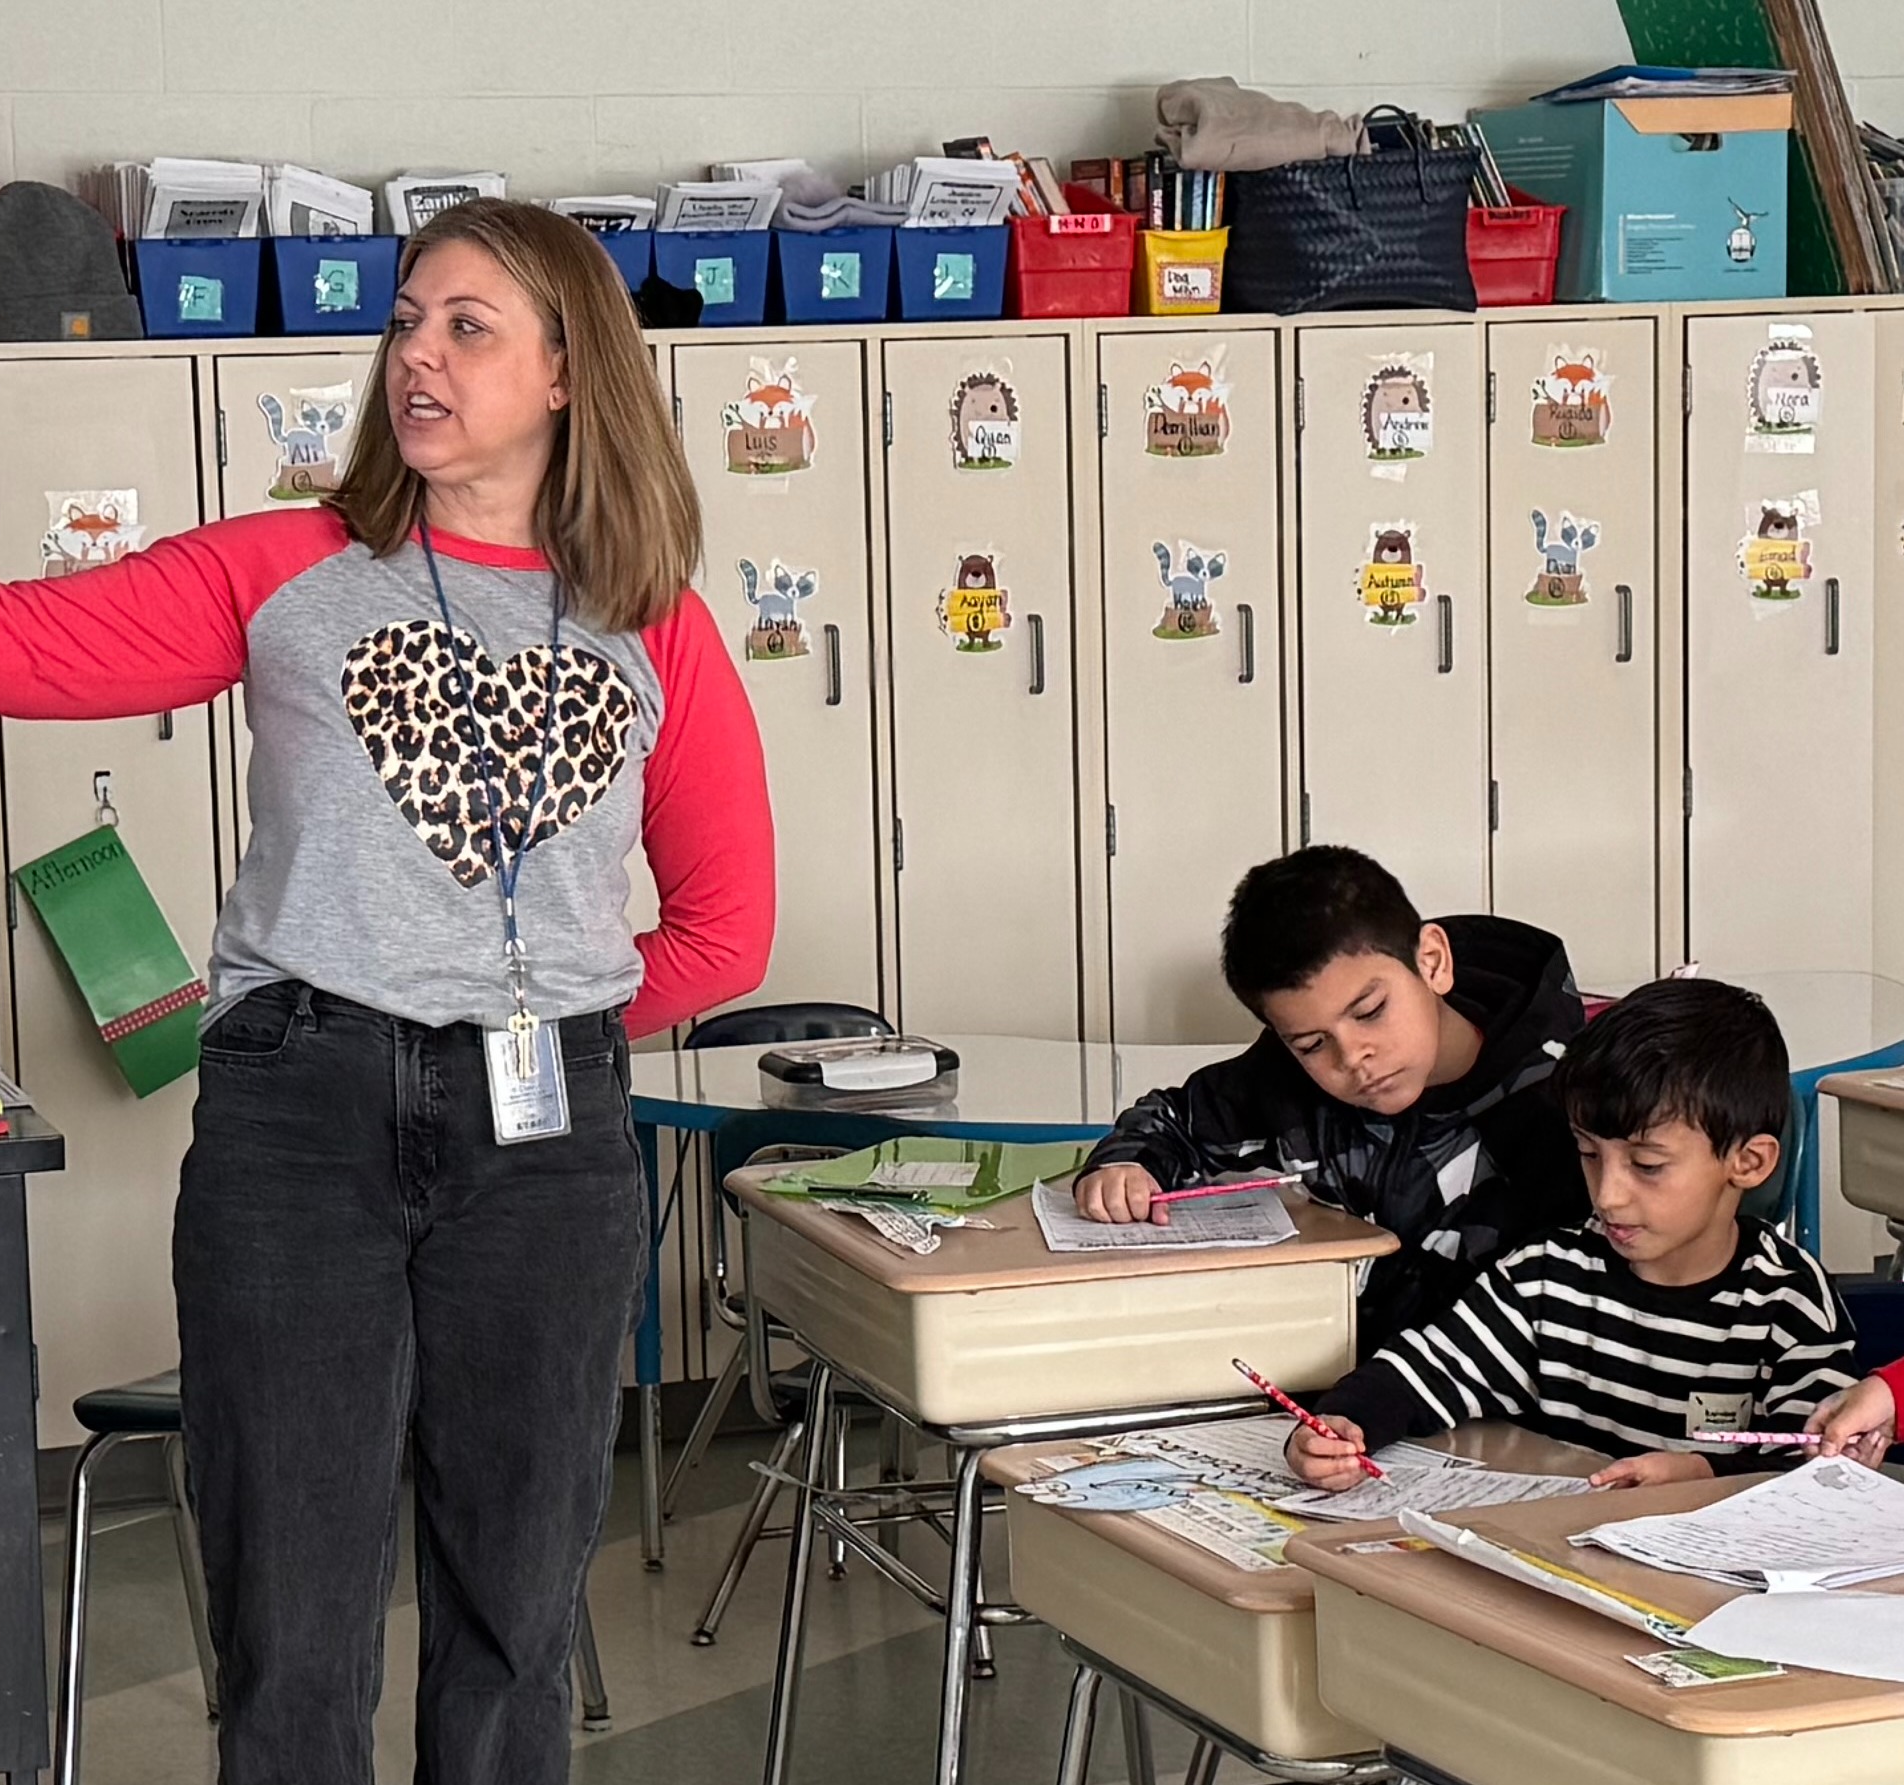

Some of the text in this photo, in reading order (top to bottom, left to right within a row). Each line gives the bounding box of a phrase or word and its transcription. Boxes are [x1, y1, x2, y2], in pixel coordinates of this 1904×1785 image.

[327, 270, 346, 293] G
[705, 266, 719, 286] J
[289, 438, 321, 463] Ali
[30, 838, 124, 896] Afternoon
